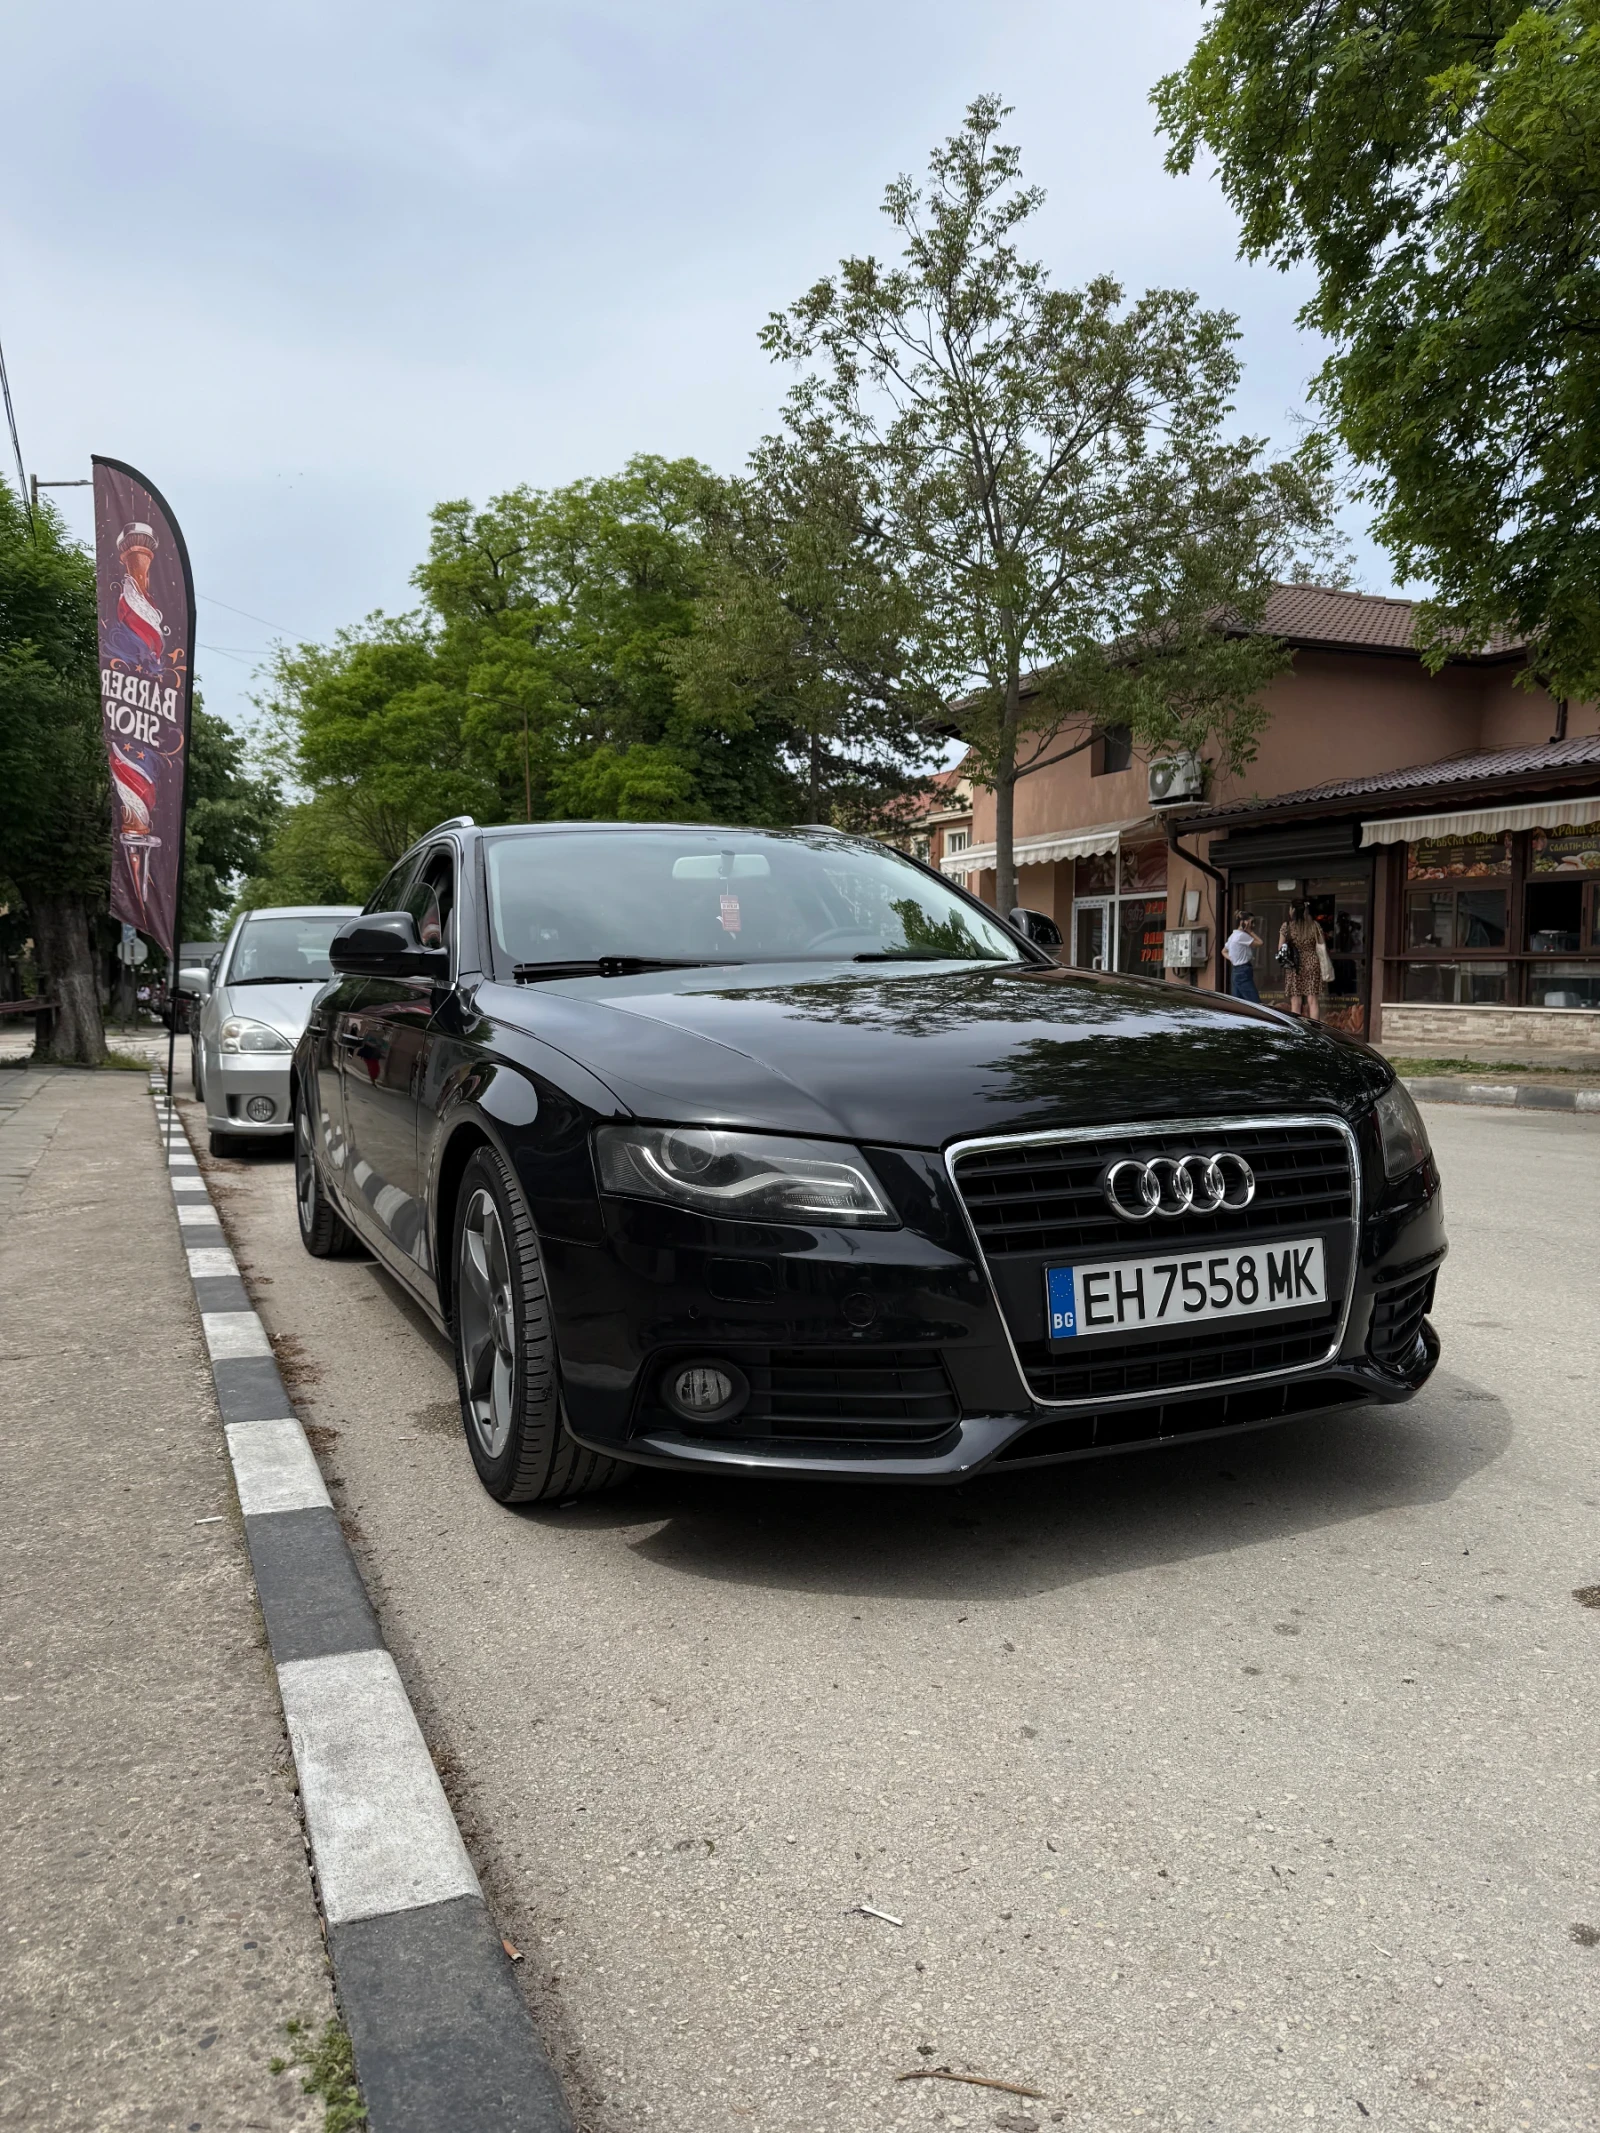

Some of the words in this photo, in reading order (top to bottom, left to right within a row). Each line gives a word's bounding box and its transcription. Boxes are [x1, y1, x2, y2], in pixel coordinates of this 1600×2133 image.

[1082, 1267, 1146, 1327] EH
[1153, 1255, 1259, 1318] 7558
[1267, 1246, 1318, 1302] MK
[1053, 1312, 1074, 1329] BG
